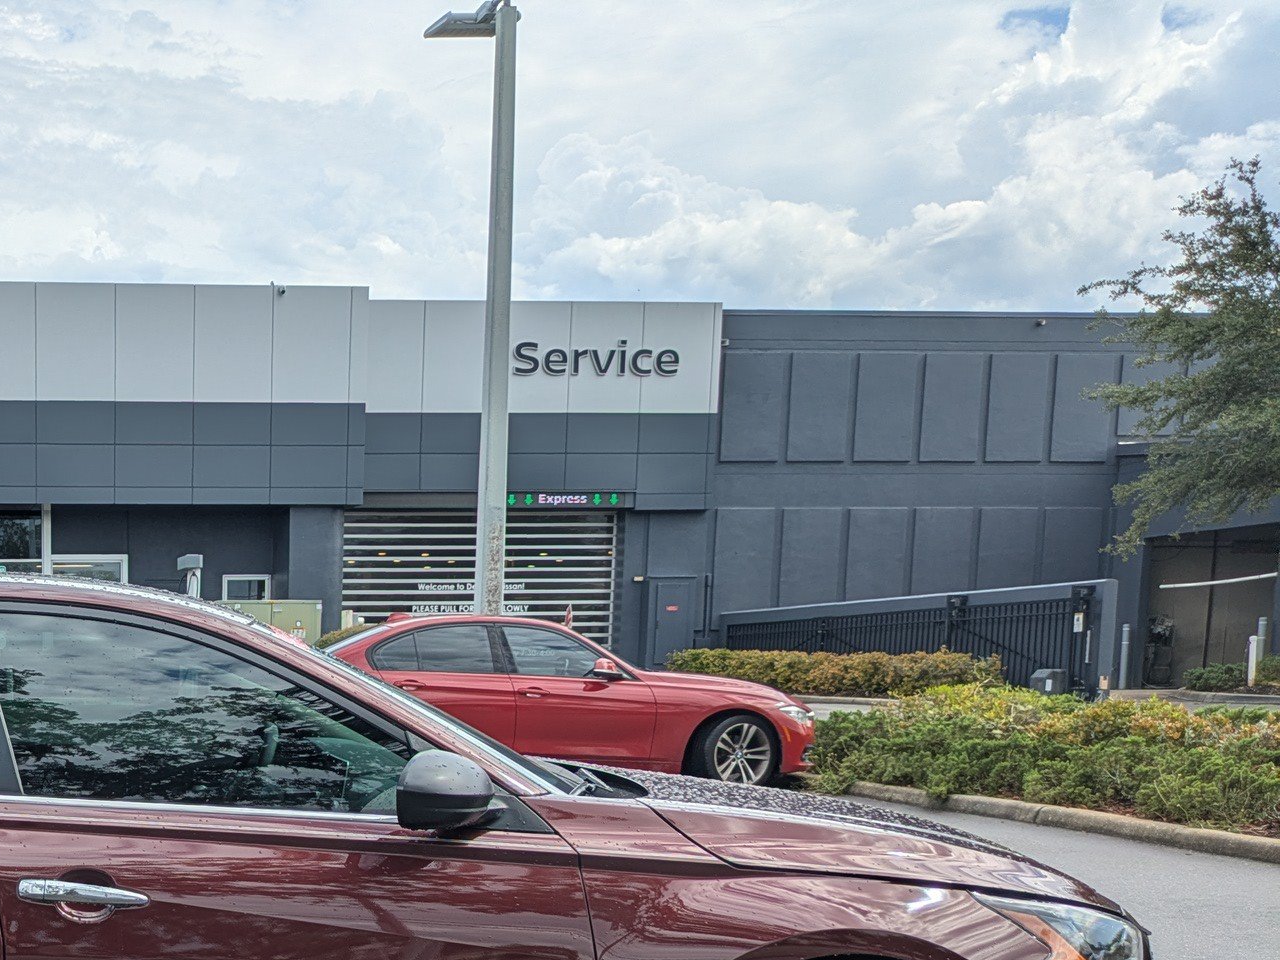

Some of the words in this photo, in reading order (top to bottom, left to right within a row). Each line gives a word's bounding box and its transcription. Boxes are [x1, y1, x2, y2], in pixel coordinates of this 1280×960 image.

[512, 339, 680, 377] Service
[538, 493, 588, 505] Express
[417, 582, 455, 591] Welcome
[456, 582, 465, 591] to
[412, 605, 439, 613] PLEASE
